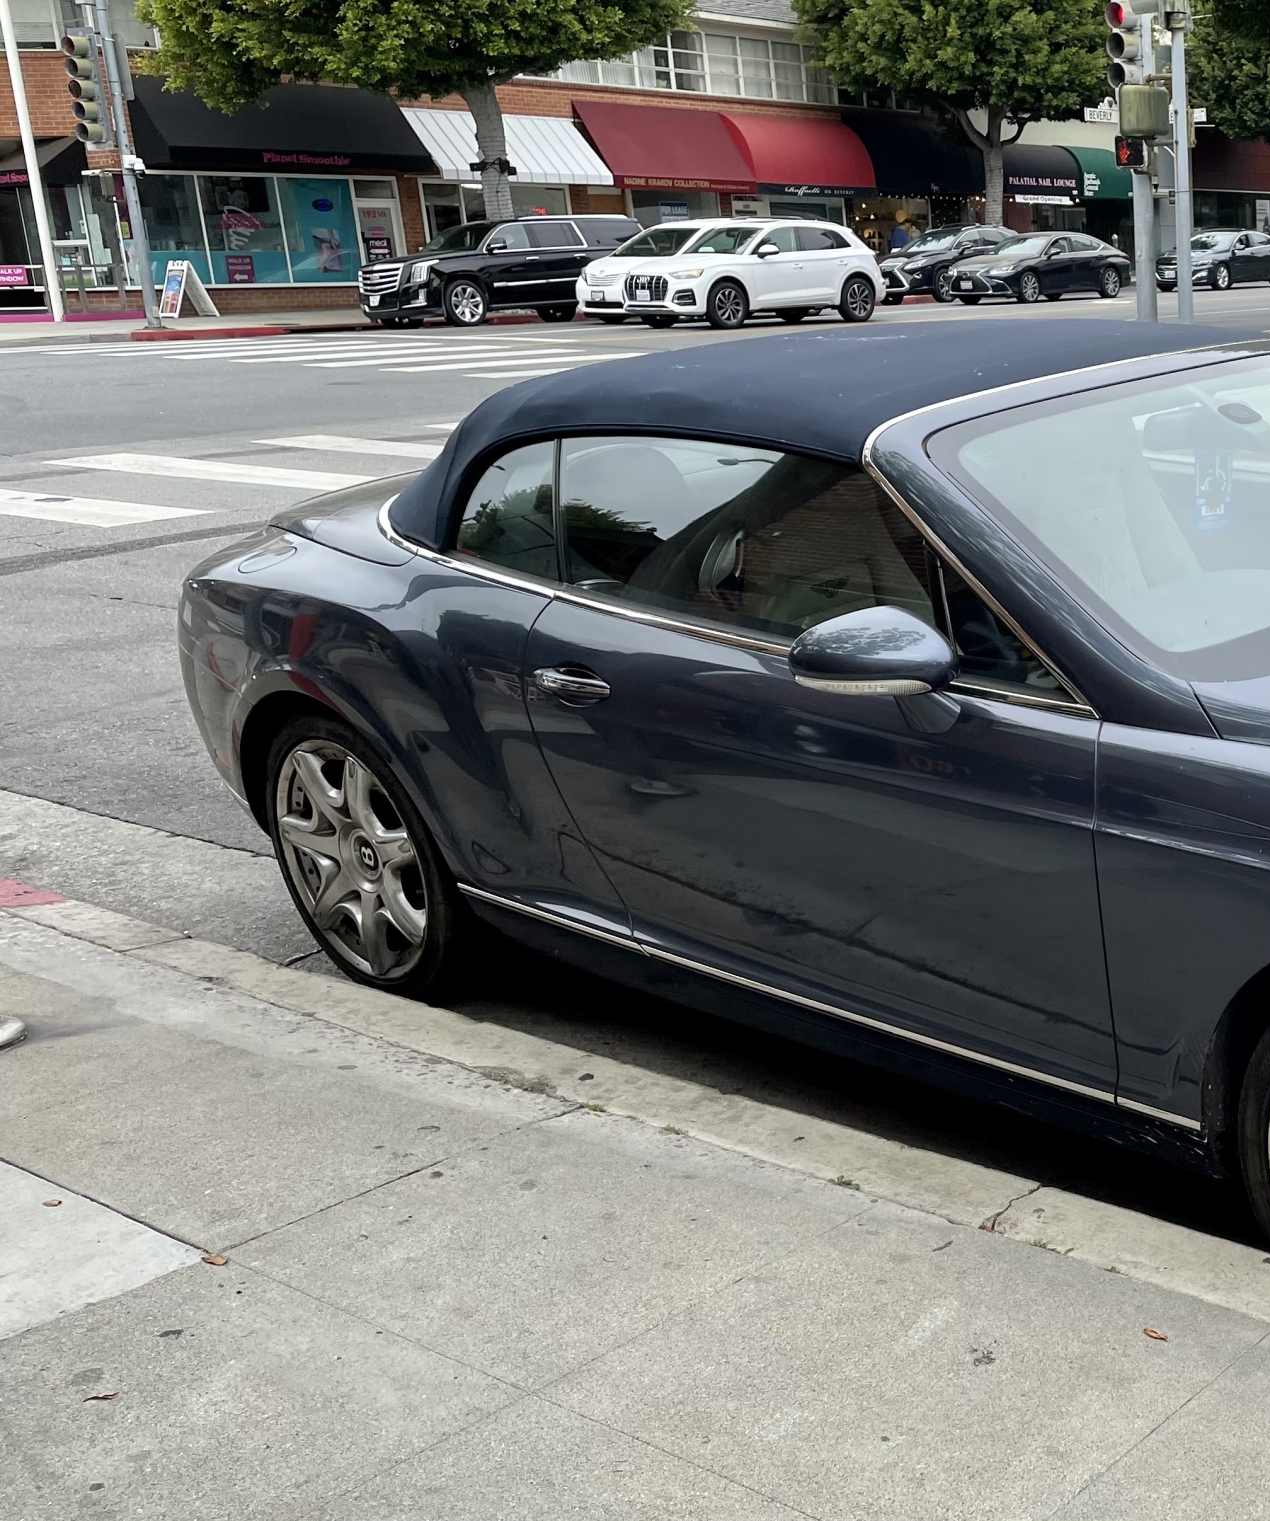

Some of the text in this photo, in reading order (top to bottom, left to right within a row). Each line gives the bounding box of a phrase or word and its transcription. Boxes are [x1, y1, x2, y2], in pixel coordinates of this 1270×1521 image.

[1088, 109, 1113, 121] BEVERLY
[624, 177, 646, 186] NADINE
[648, 179, 673, 187] KRAKOV
[674, 180, 710, 188] COLLECTION
[1009, 177, 1077, 187] PALATIAL NAIL LOUNGE
[661, 205, 688, 214] FOR LEASE
